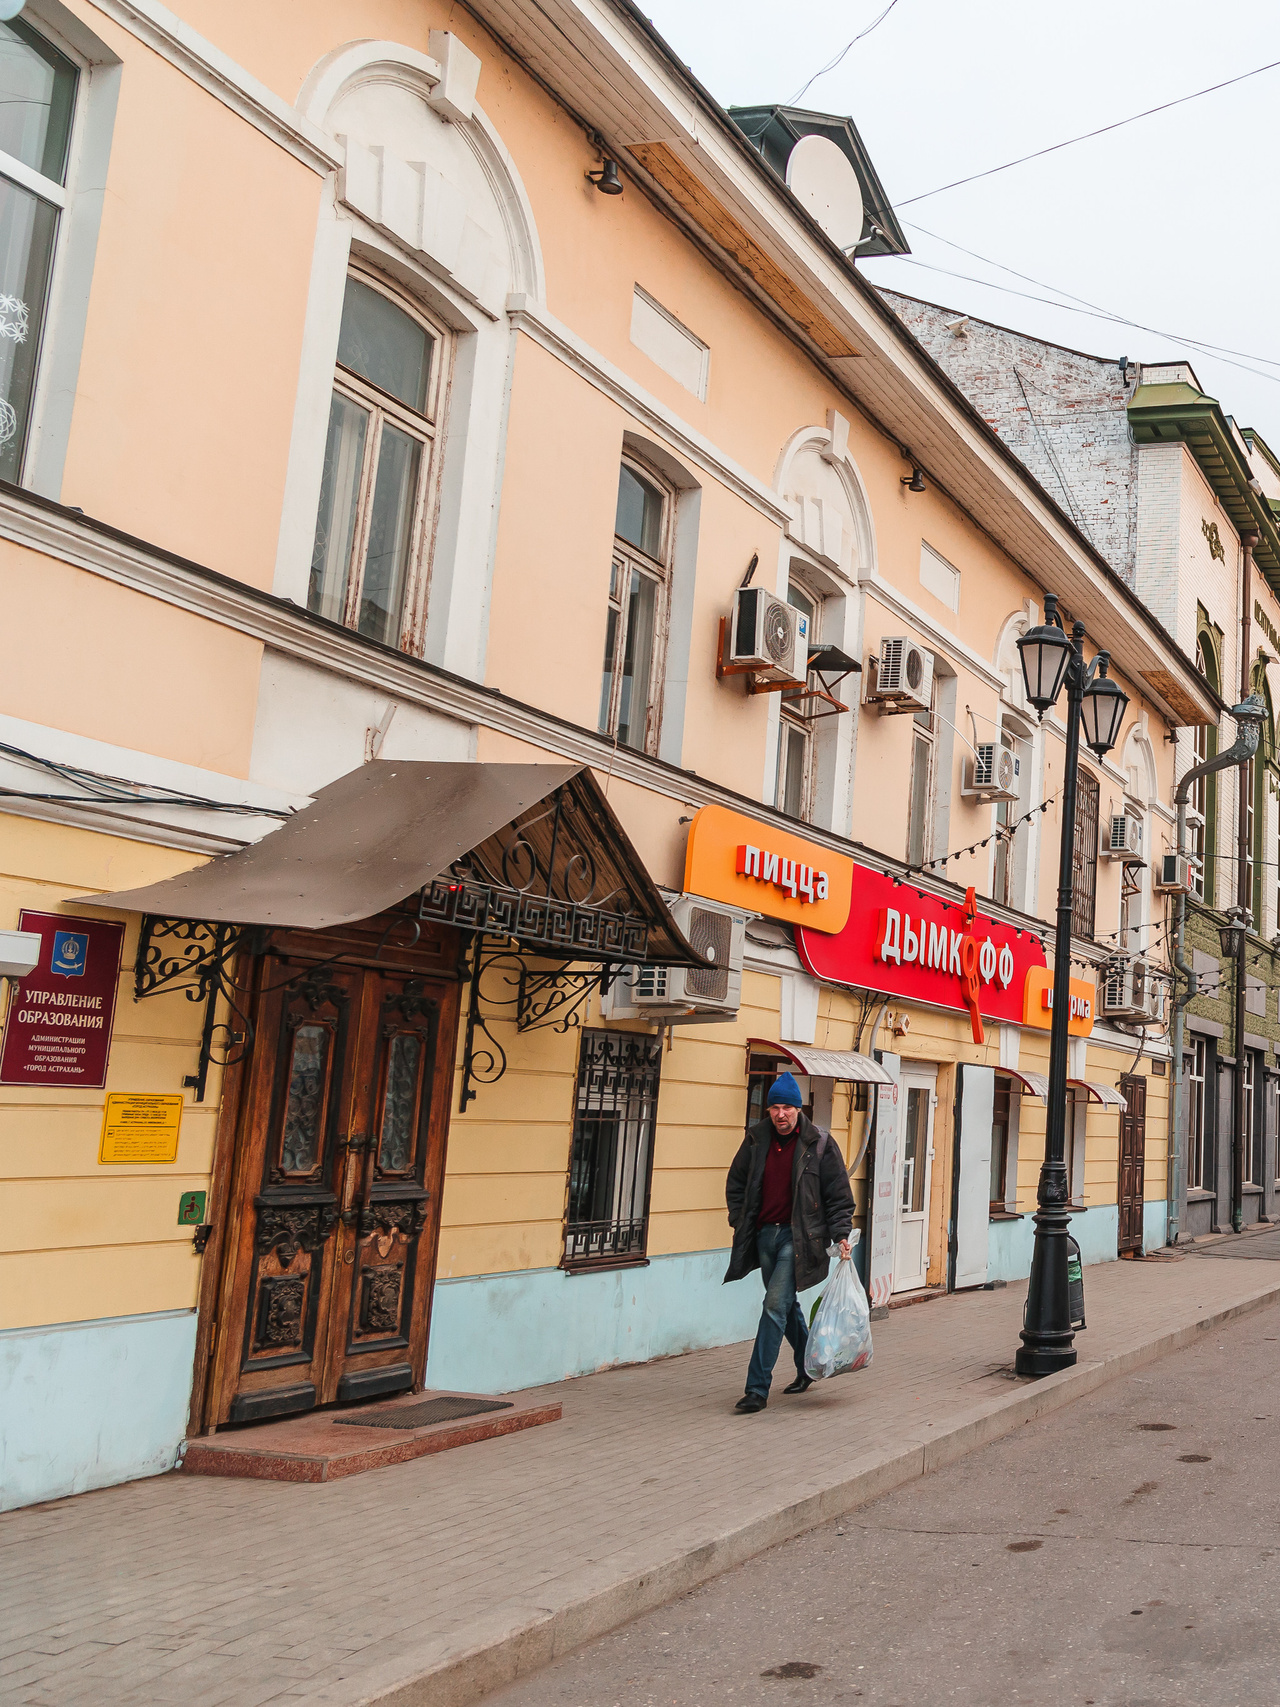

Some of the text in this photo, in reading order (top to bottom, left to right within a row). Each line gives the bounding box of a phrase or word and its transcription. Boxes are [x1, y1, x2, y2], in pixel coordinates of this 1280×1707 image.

[879, 907, 1014, 990] ДЫМКОФФ
[25, 990, 103, 1009] УПРАВЛЕНИЕ
[1046, 988, 1091, 1021] шрма
[18, 1009, 104, 1029] ОБРАЗОВАНИЯ
[31, 1035, 86, 1044] АДМИНИСТРАЦИИ
[28, 1044, 86, 1054] МУНИЦИПАЛЬНОГО
[34, 1055, 78, 1064] ОБРАЗОВАНИЯ
[23, 1064, 85, 1074] «ГОРОД АСТРАХАНЬ»
